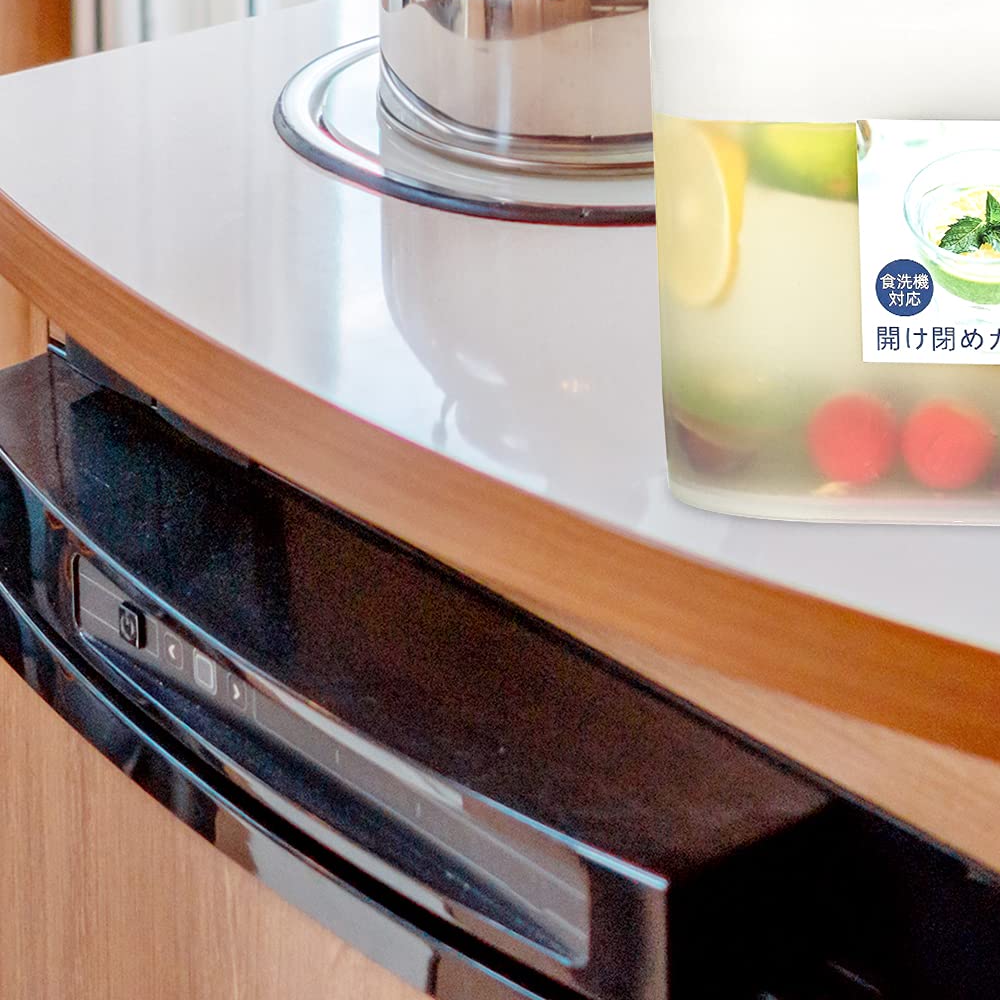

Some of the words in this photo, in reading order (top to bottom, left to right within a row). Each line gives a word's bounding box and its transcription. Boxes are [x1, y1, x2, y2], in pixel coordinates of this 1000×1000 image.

[879, 273, 930, 290] 食洗機
[888, 290, 922, 307] 対応
